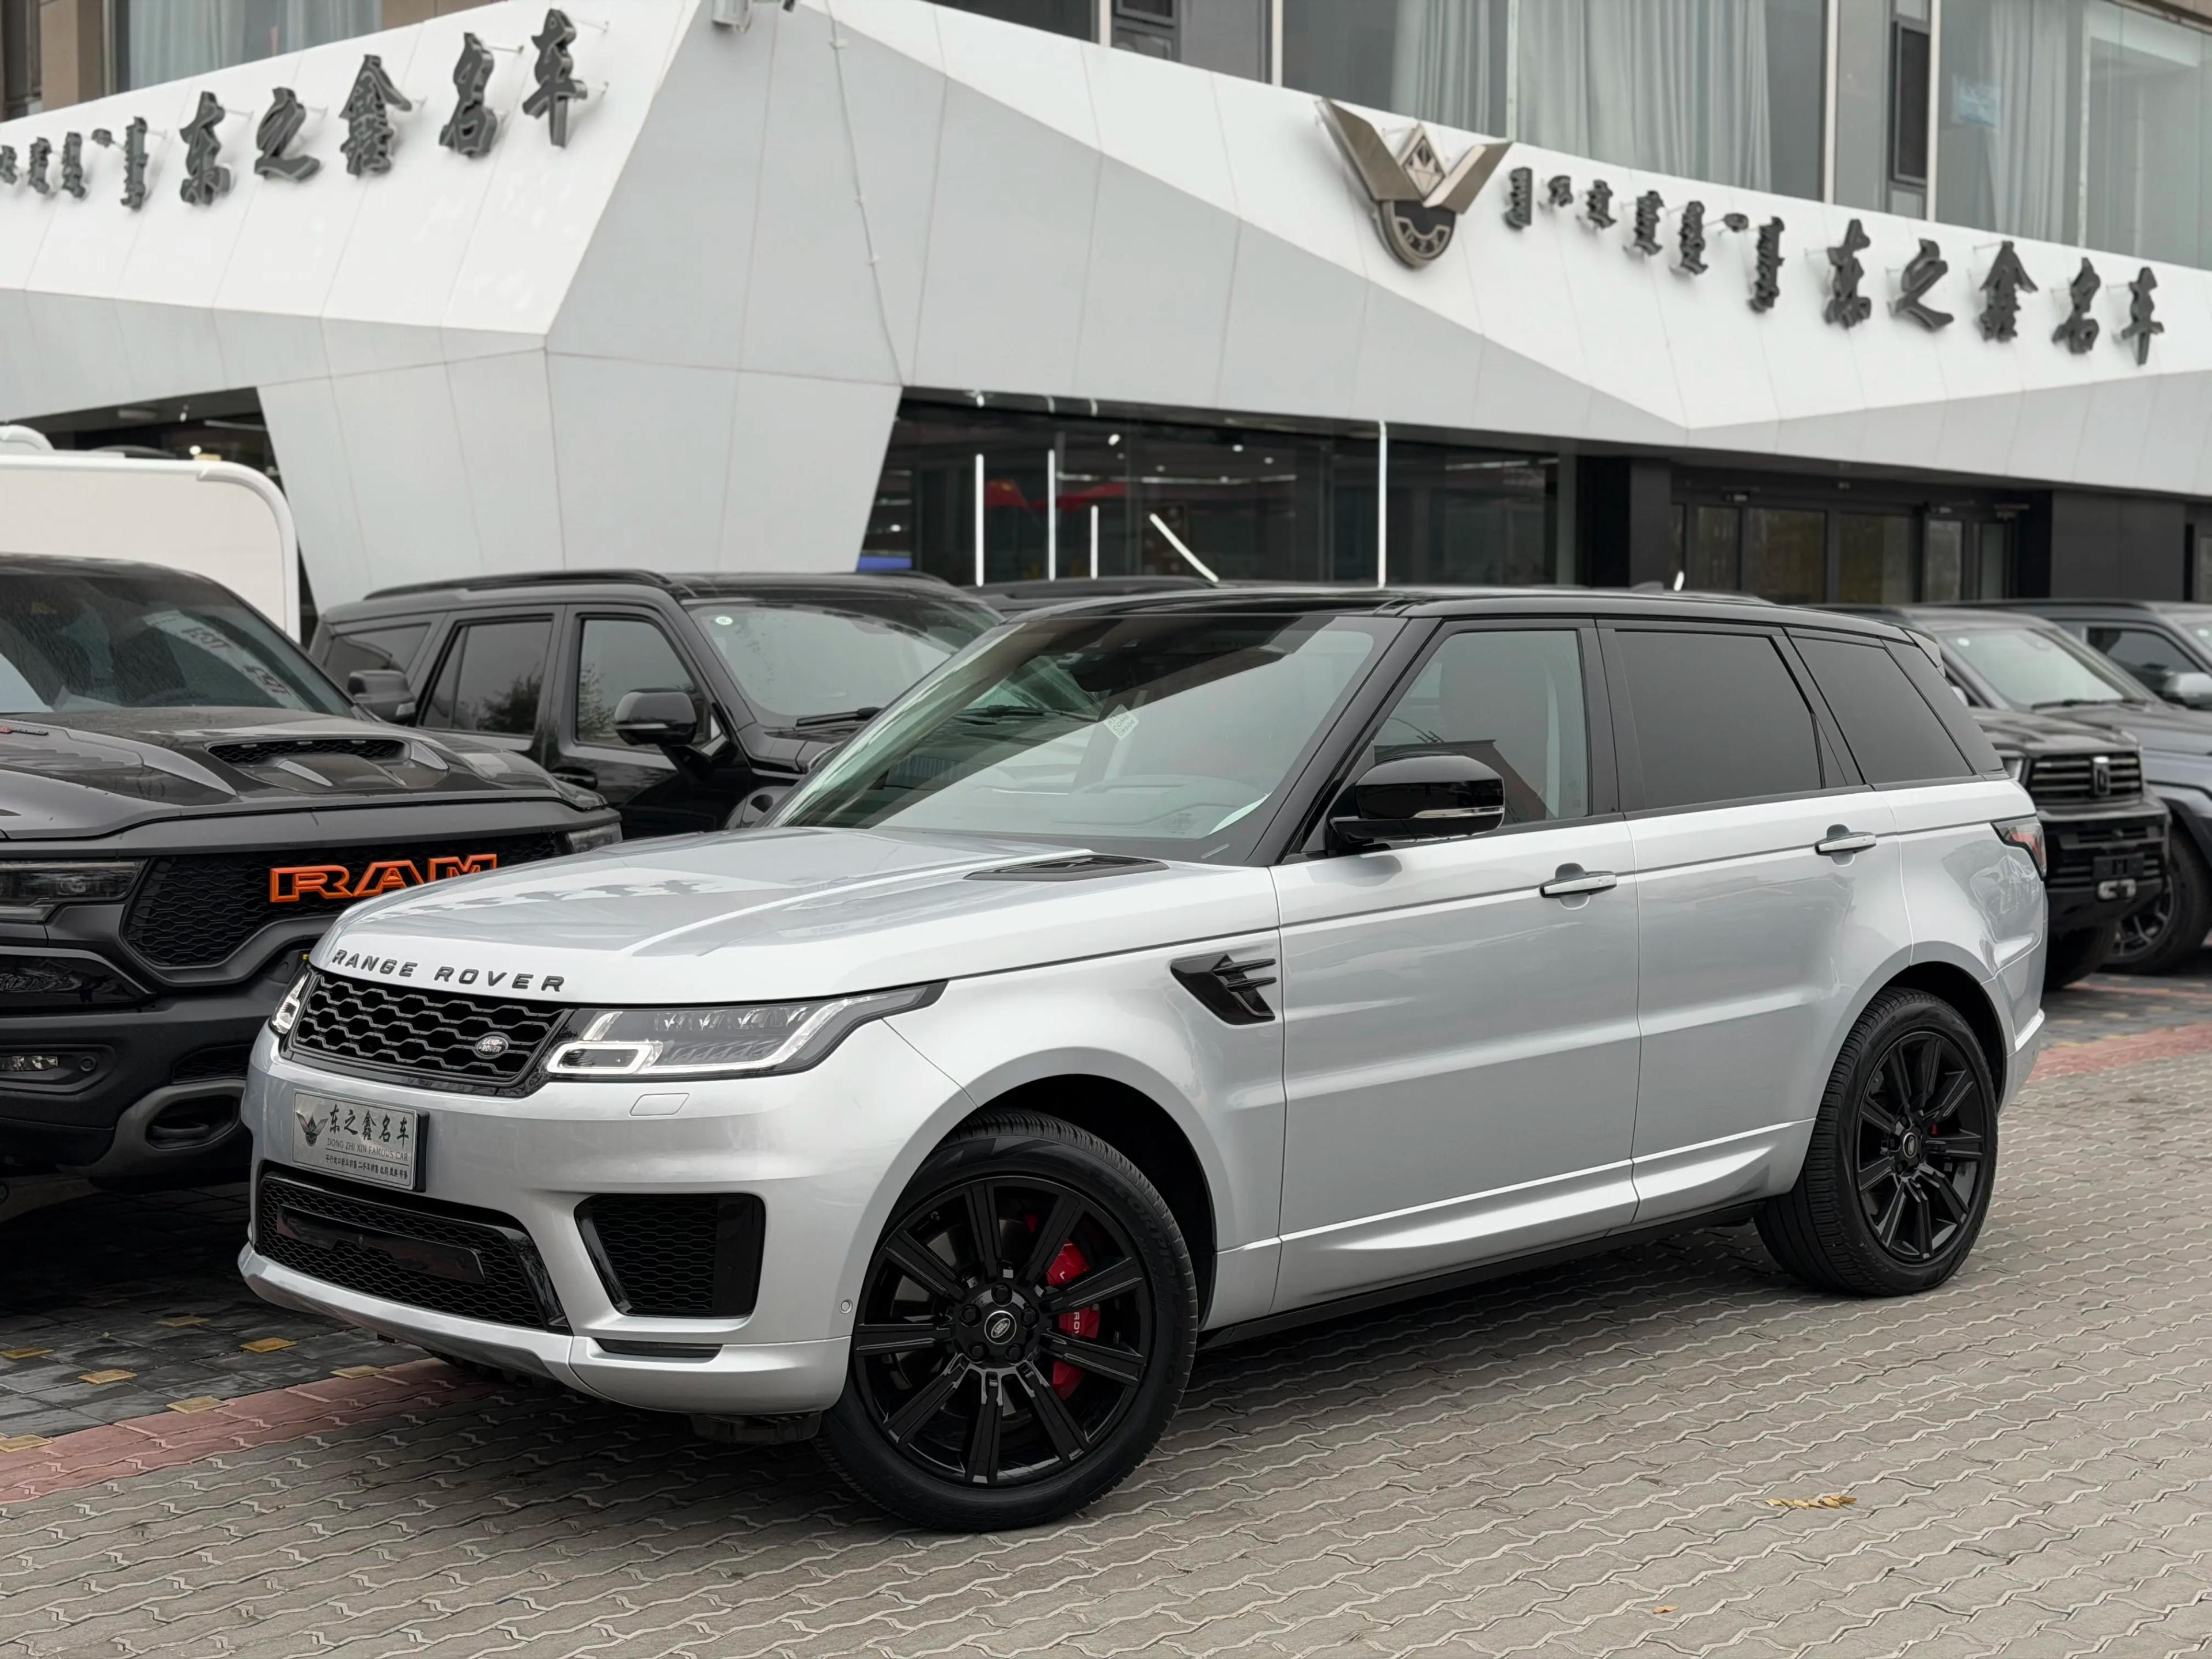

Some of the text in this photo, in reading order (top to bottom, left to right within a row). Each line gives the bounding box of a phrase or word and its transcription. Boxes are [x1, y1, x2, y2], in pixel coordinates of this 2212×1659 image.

[270, 854, 497, 903] RAM
[332, 949, 565, 992] RANGE ROVER
[481, 1045, 502, 1053] ROVER
[329, 1104, 410, 1148] 东之鑫名车
[327, 1138, 408, 1162] DONG ZHI XIN FAMOUS CAR
